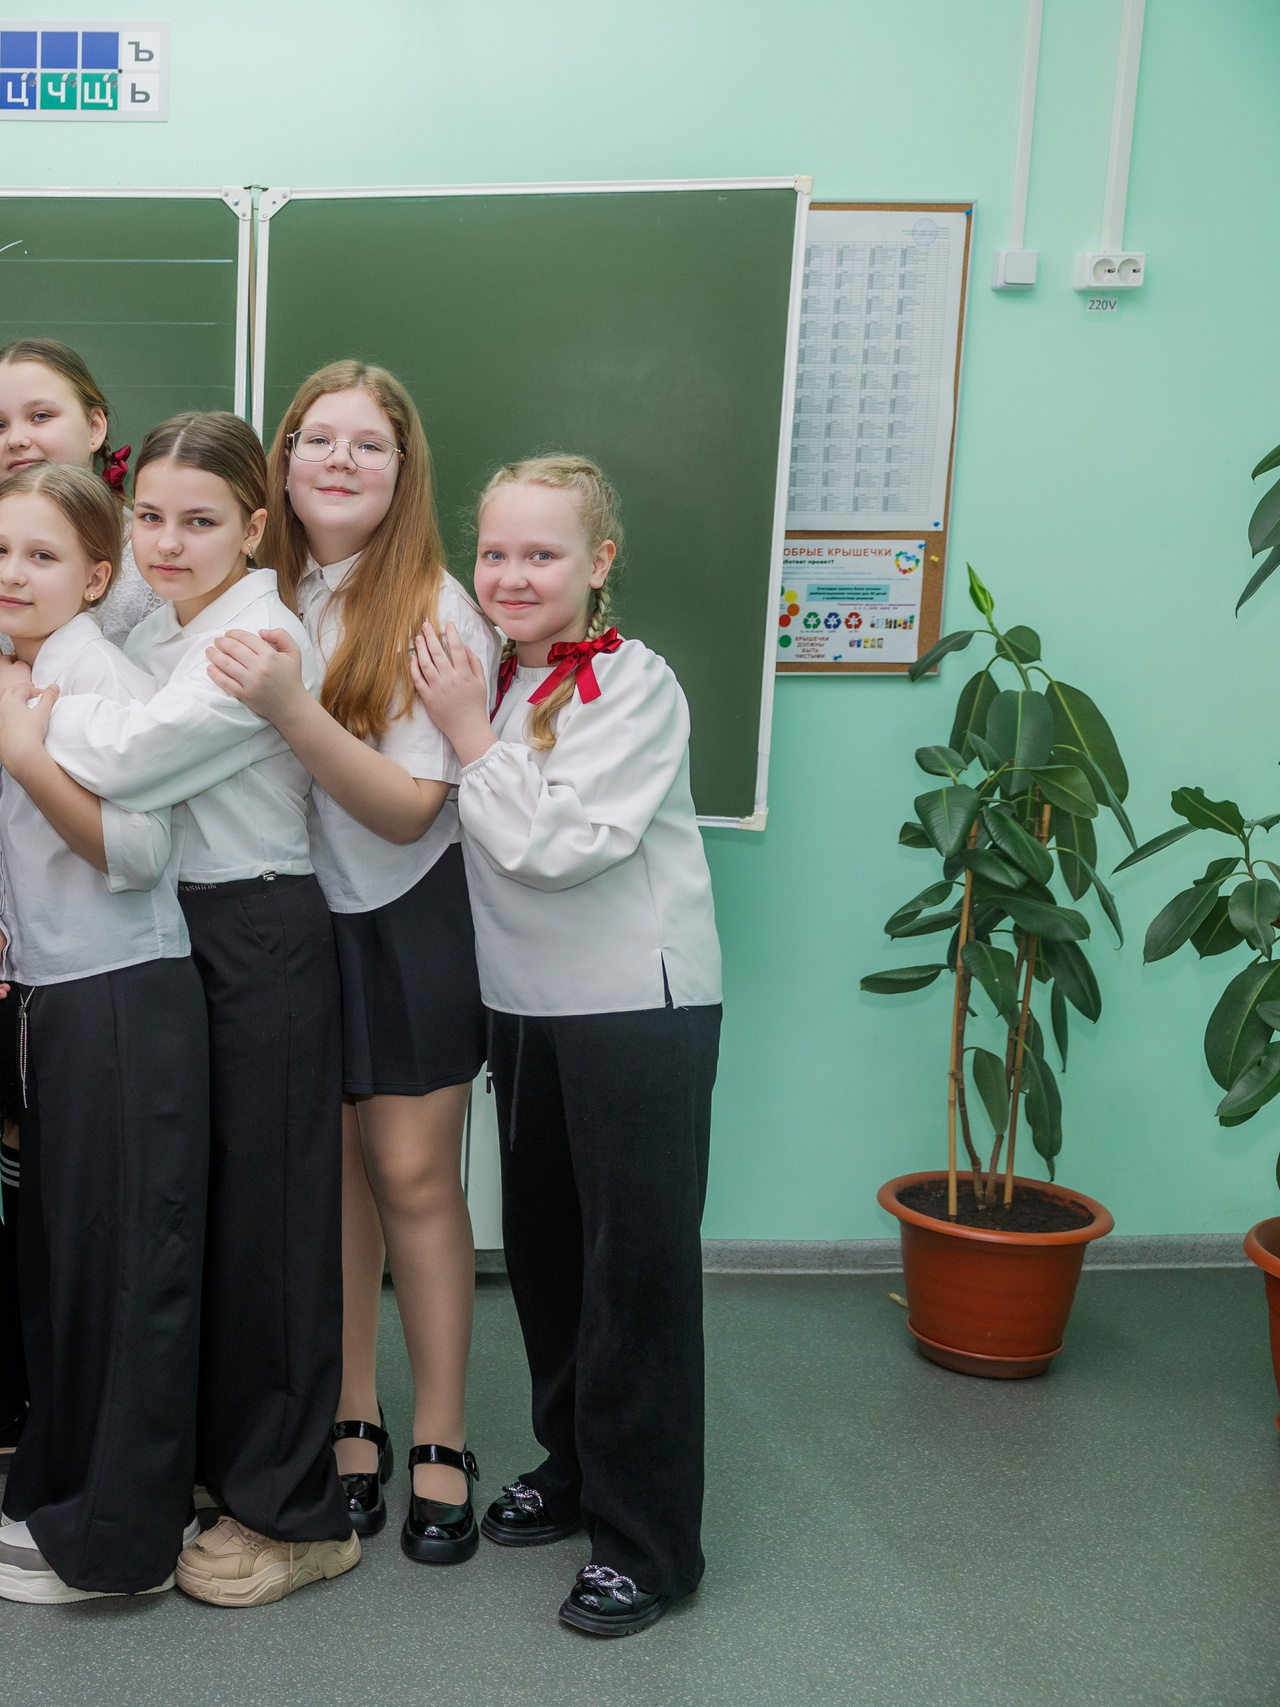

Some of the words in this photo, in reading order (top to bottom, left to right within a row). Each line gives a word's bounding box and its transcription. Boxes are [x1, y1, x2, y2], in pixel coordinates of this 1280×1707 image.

[127, 42, 154, 62] Ъ
[7, 82, 29, 107] Ц
[47, 82, 66, 102] Ч
[83, 82, 113, 107] Щ
[130, 83, 150, 103] Ь
[1088, 300, 1117, 310] 220V
[783, 547, 824, 557] ОБРЫЕ
[827, 547, 892, 557] КРЫШЕЧКИ
